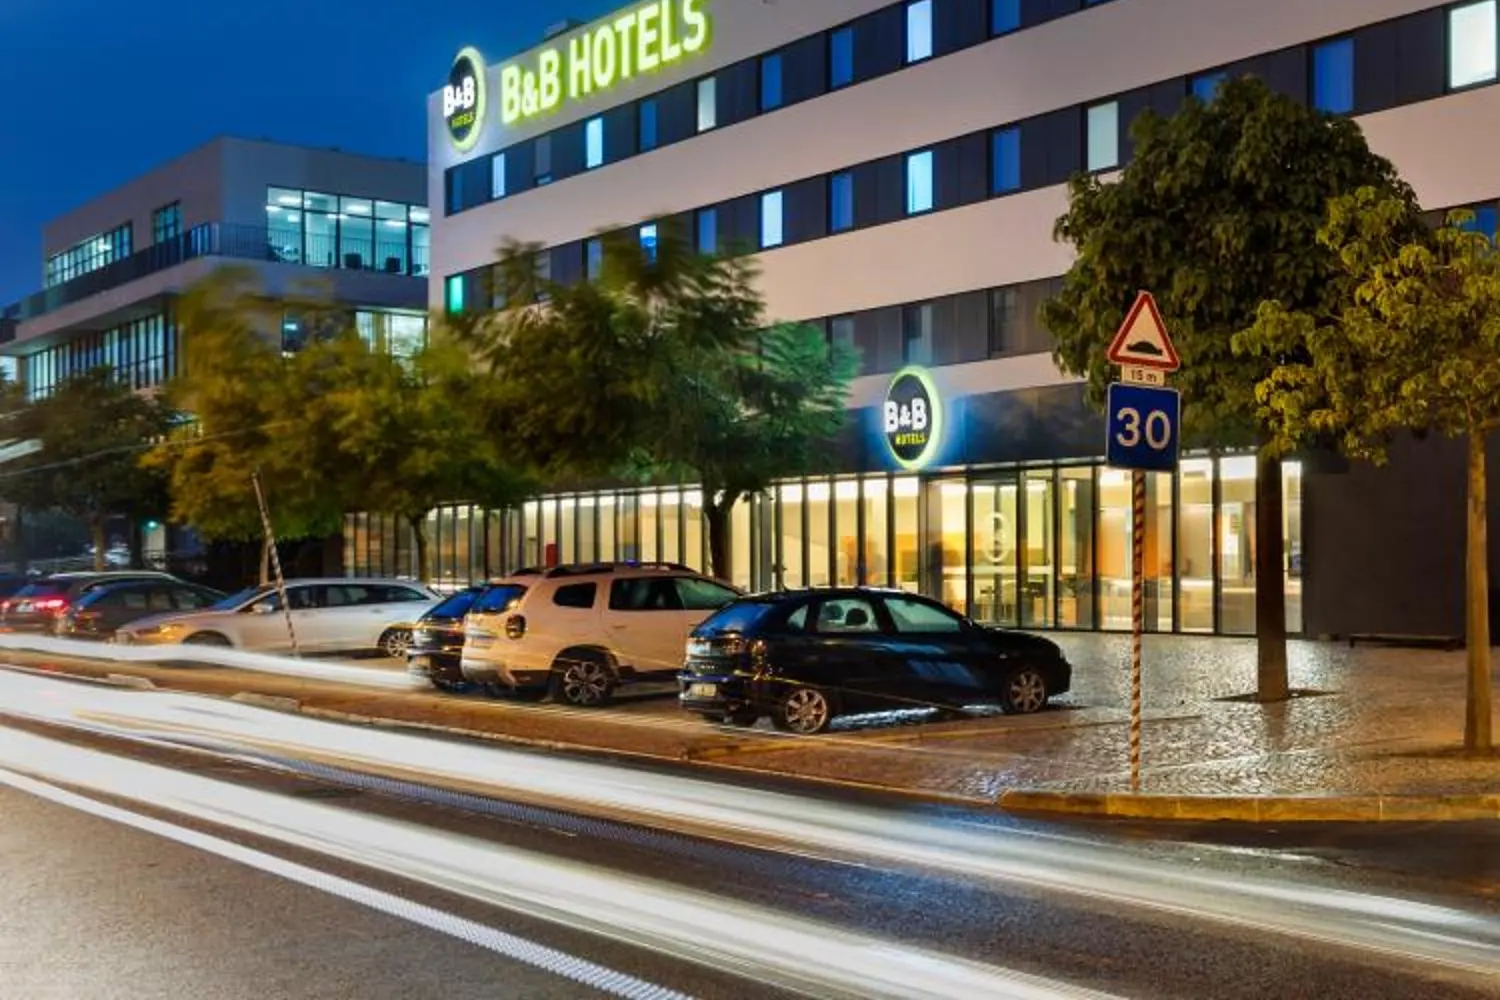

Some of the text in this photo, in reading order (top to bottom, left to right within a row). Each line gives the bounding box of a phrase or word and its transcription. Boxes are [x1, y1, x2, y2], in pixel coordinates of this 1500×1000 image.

[443, 75, 475, 117] B&B
[501, 48, 560, 124] B&B
[1131, 369, 1143, 381] 15
[883, 397, 927, 433] B&B
[1116, 407, 1171, 450] 30
[895, 432, 926, 445] HOTELS
